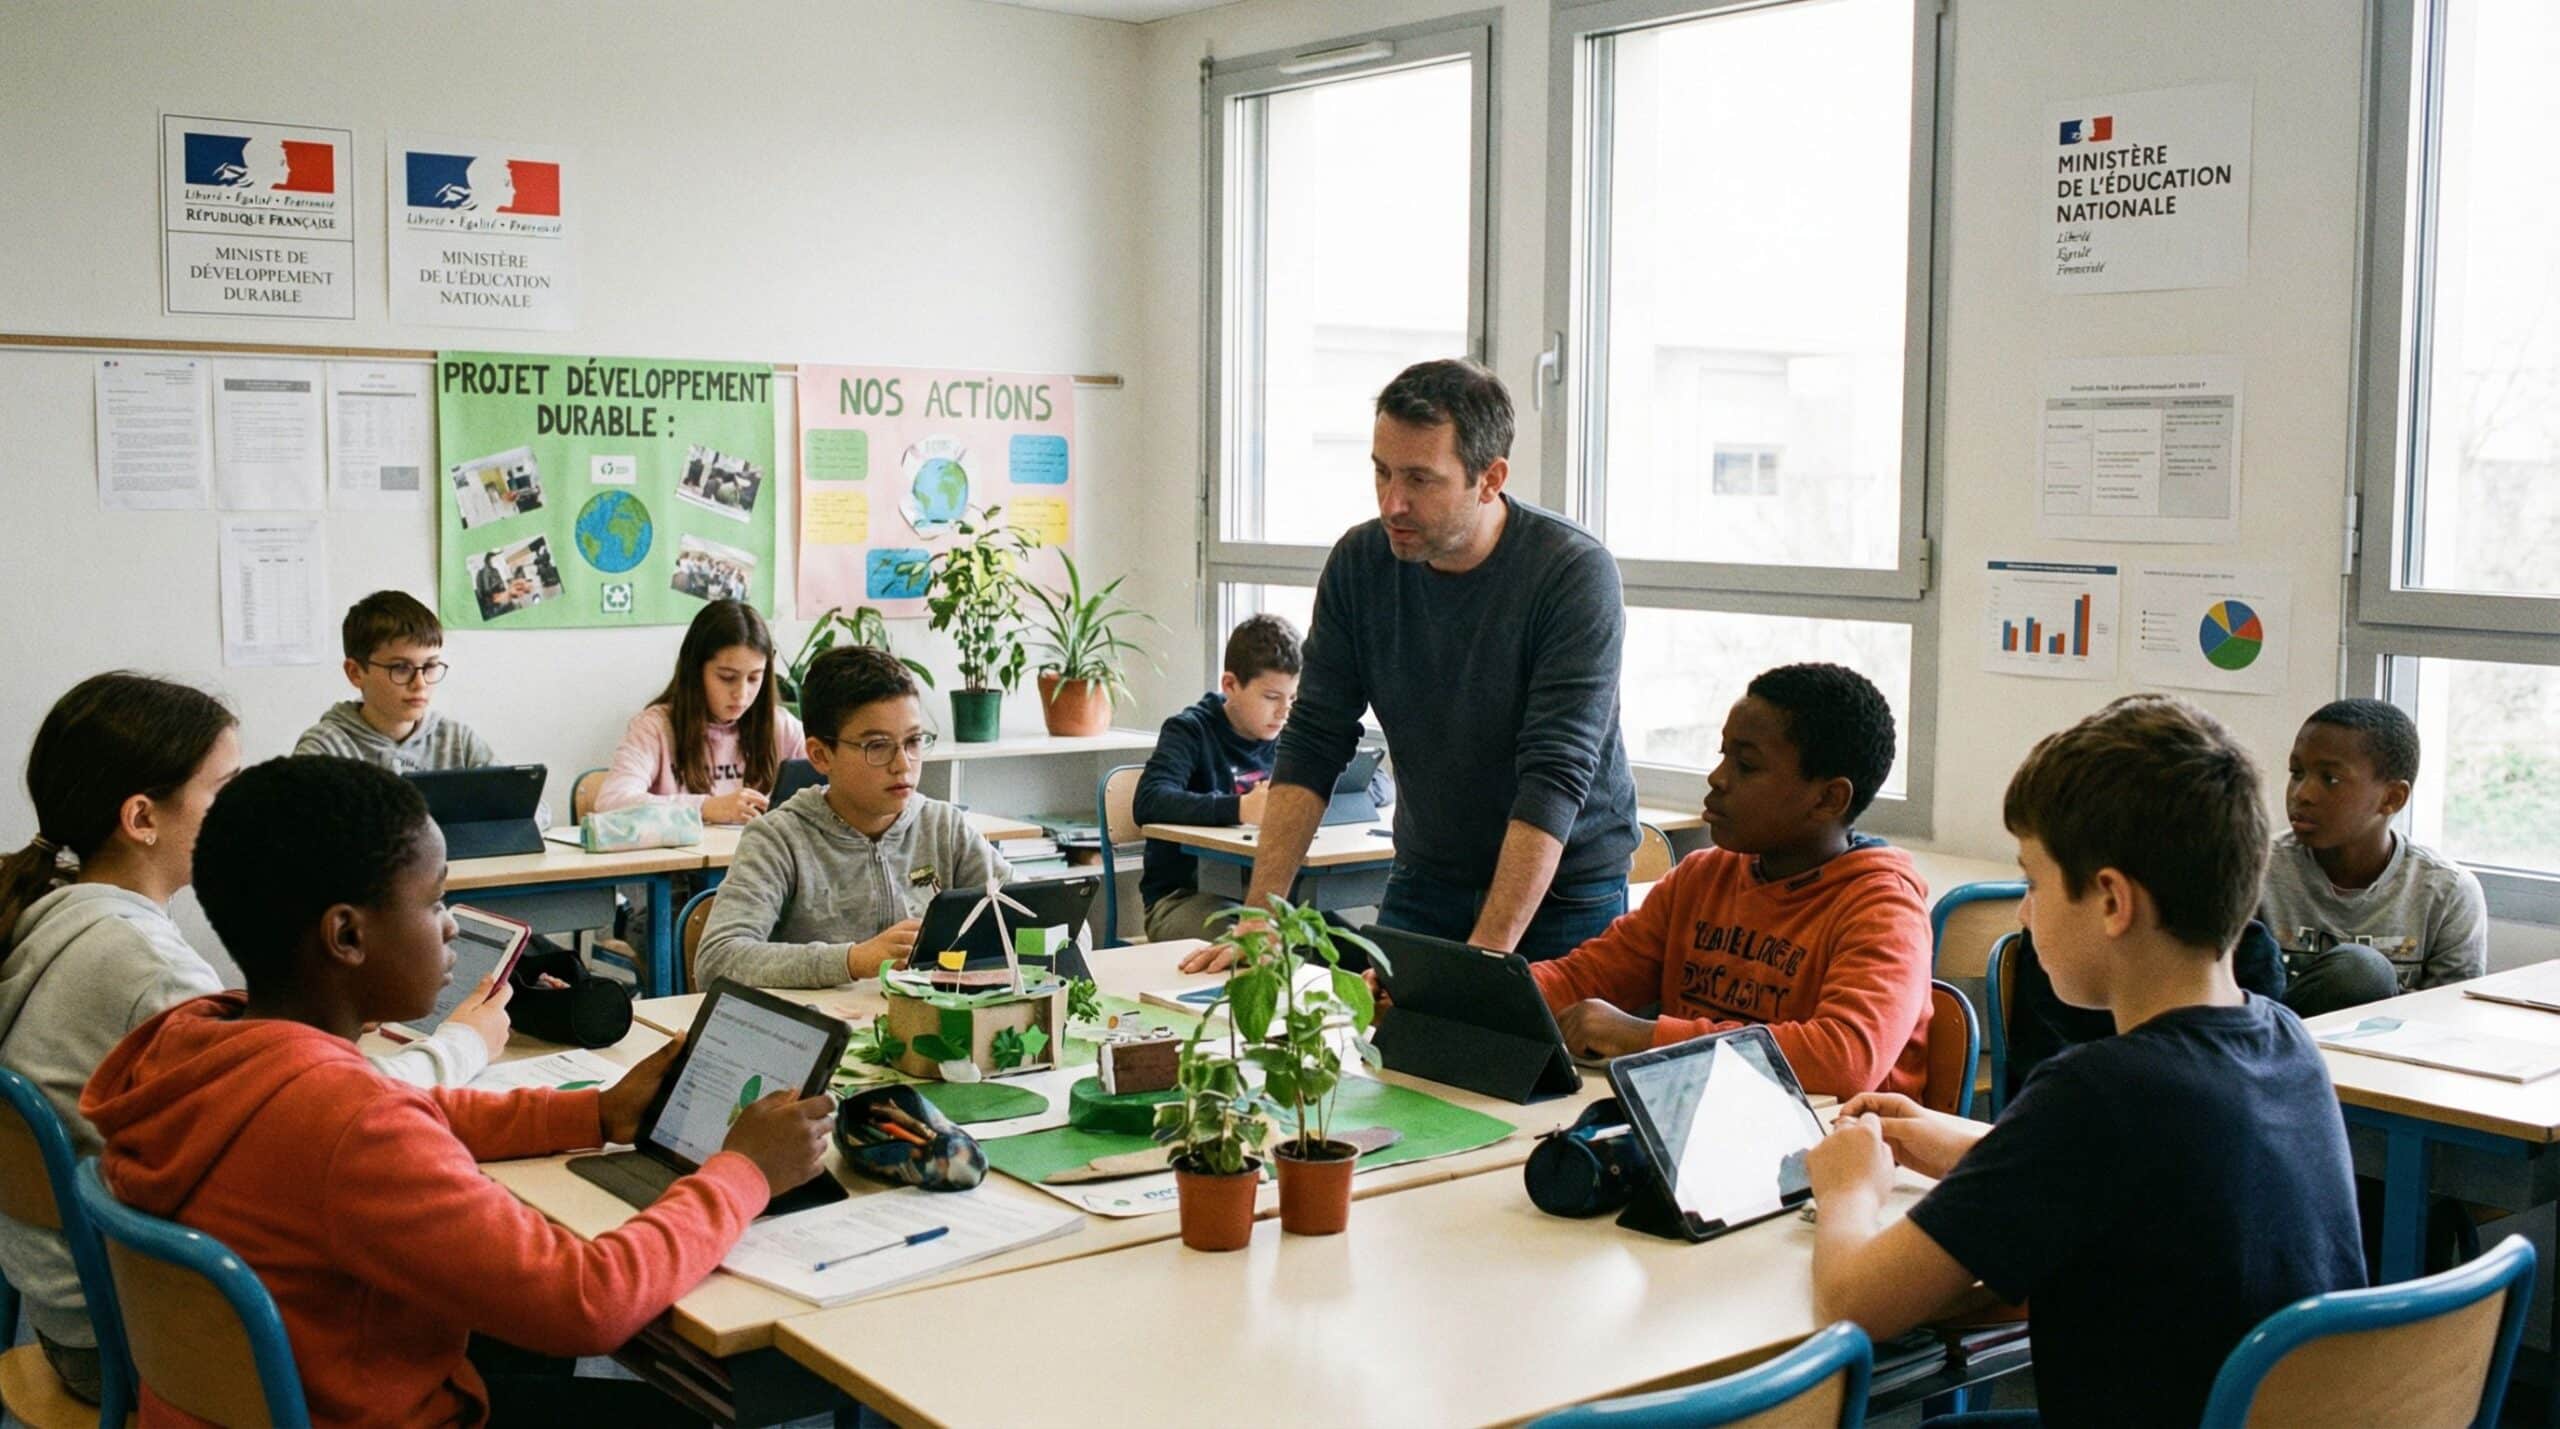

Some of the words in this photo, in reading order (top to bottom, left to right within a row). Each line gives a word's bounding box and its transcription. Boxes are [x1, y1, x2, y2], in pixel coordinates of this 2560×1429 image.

[2058, 144, 2168, 174] MINISTÈRE
[2057, 178, 2083, 198] DE
[2056, 196, 2177, 223] NATIONALE
[269, 213, 336, 230] FRANÇAISE
[215, 246, 283, 263] MINISTE
[287, 250, 309, 264] DE
[441, 250, 528, 269] MINISTÈRE
[190, 263, 335, 285] DÉVELOPPEMENT
[419, 268, 442, 284] DE
[223, 286, 303, 303] DURABLE
[440, 290, 532, 308] NATIONALE
[444, 361, 550, 395] PROJET
[567, 358, 772, 403] DÉVELOPPEMENT
[840, 377, 905, 417] NOS
[537, 404, 657, 438] DURABLE
